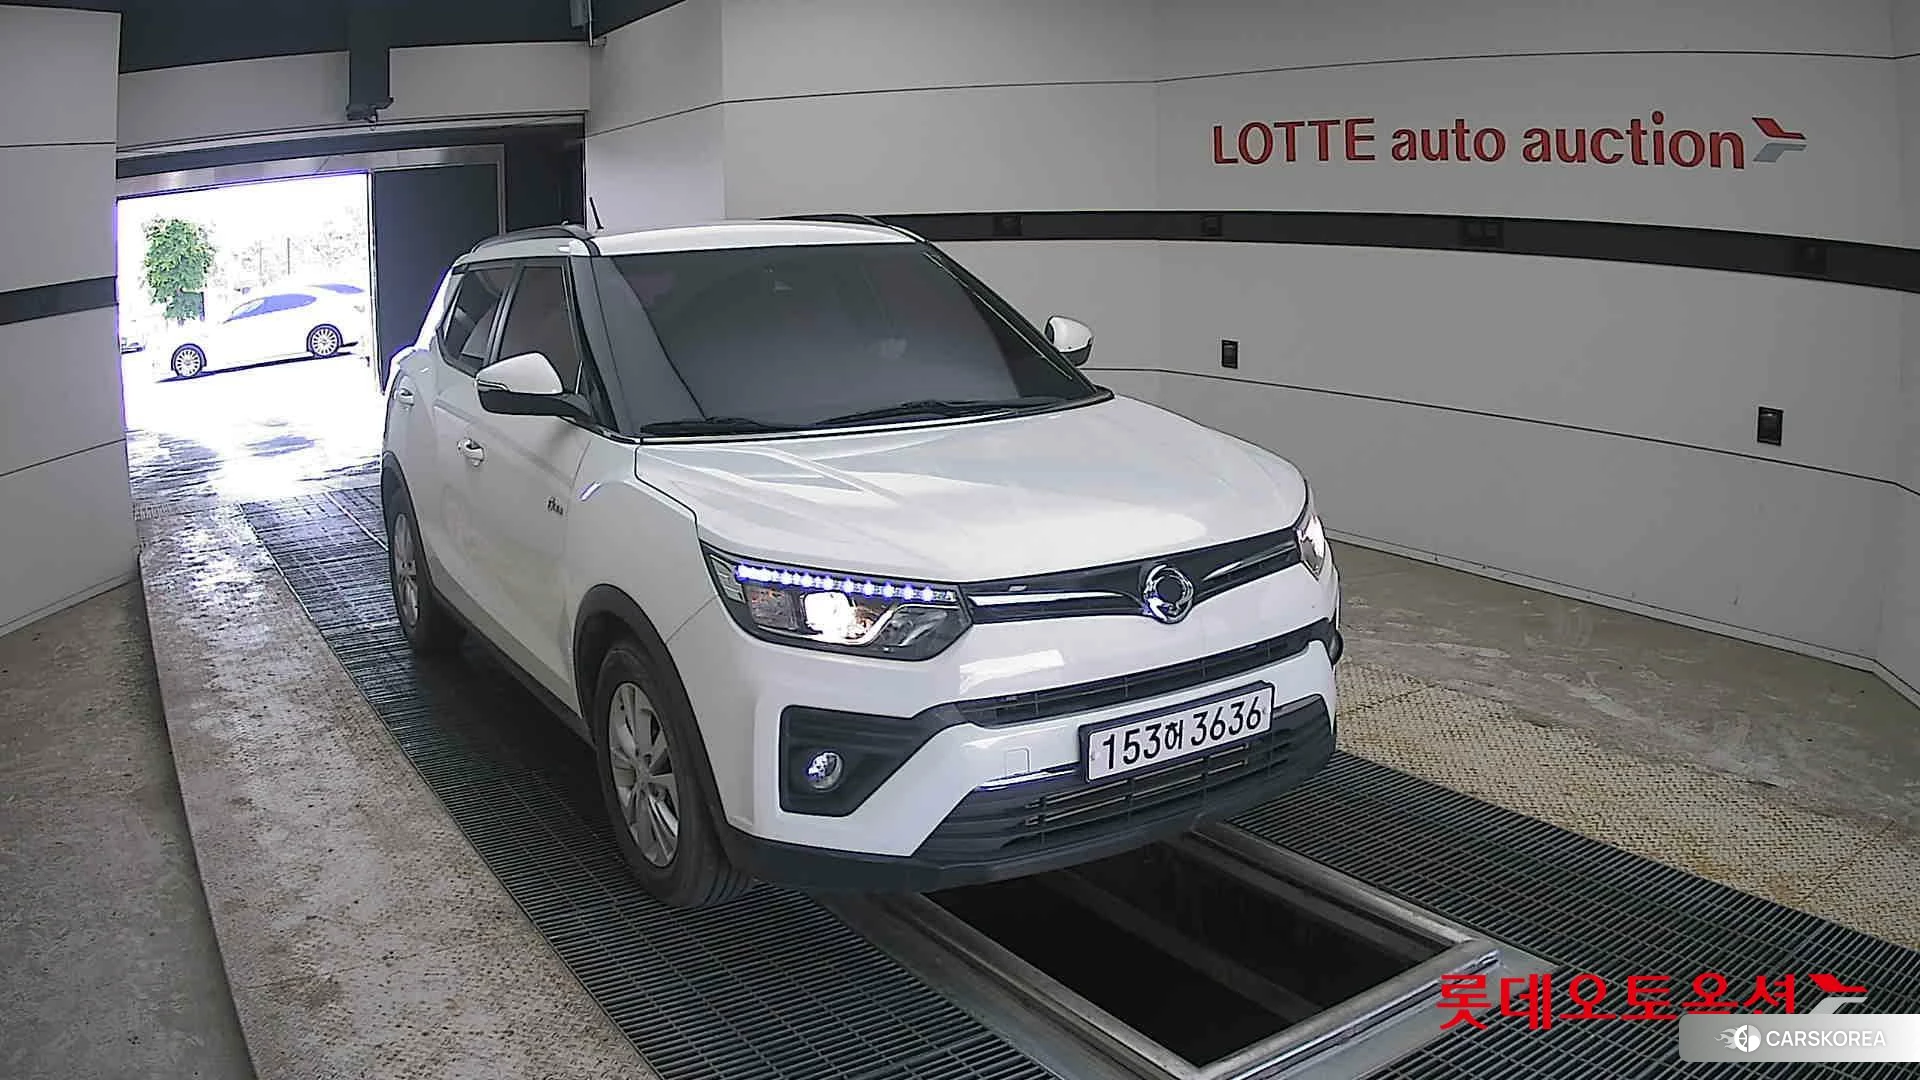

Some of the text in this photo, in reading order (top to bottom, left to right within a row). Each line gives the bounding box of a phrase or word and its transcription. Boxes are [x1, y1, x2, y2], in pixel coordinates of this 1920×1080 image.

[1212, 110, 1745, 170] LOTTE auto auction
[1102, 695, 1263, 770] 153허 3636
